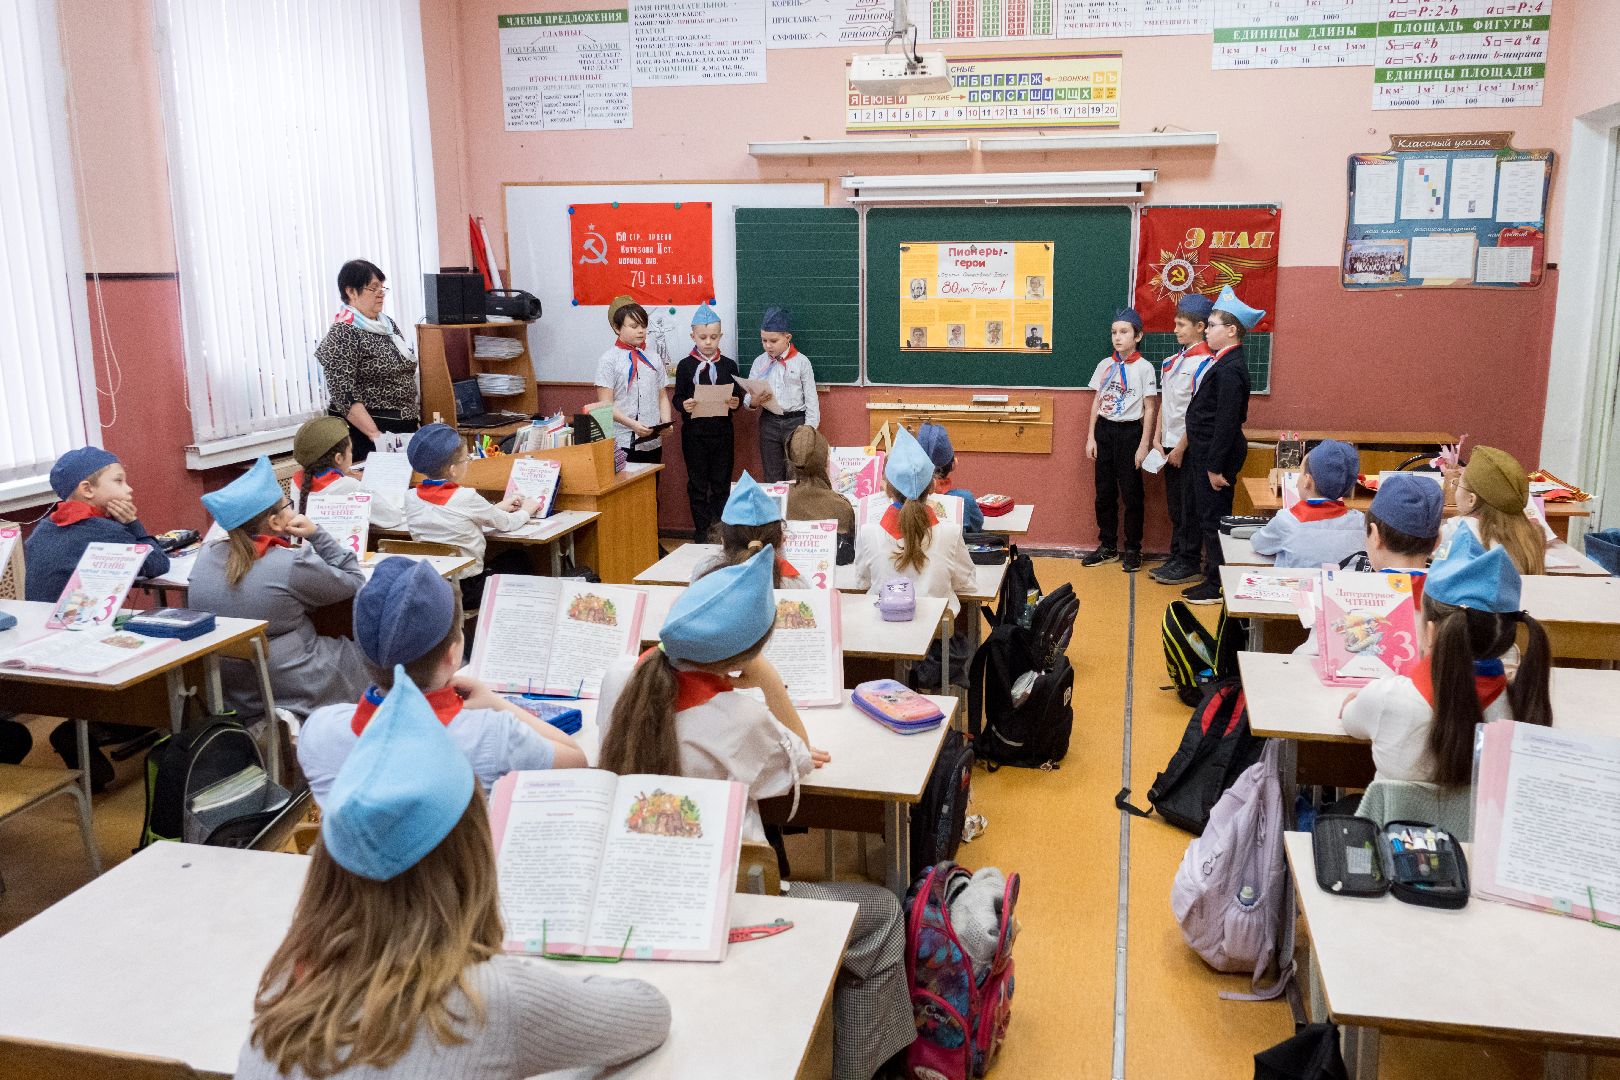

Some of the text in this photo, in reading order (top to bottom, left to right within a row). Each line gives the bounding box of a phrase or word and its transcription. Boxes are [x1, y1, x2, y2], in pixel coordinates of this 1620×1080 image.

[507, 12, 622, 26] ЧЛЕНЫ ПРЕДЛОЖЕНИЯ
[1393, 18, 1533, 34] ПЛОЩАДЬ ФИГУРЫ
[542, 29, 583, 38] ГЛАВНЫЕ
[1233, 26, 1357, 42] ЕДИНИЦЫ ДЛИНЫ
[1385, 66, 1533, 82] ЕДИНИЦЫ ПЛОЩАДИ
[878, 111, 883, 119] 3
[917, 110, 922, 118] 6
[957, 109, 963, 117] 9
[968, 109, 978, 117] 10
[995, 108, 1005, 116] 12
[1008, 108, 1018, 116] 13
[1022, 107, 1032, 115] 14
[1036, 107, 1046, 115] 15
[1049, 107, 1059, 115] 16
[1077, 106, 1087, 114] 18
[1091, 106, 1101, 114] 19
[1397, 138, 1491, 149] Классный уголок
[616, 231, 627, 242] 150
[1184, 227, 1275, 249] 9 МАЯ
[948, 247, 1008, 258] Пионеры-
[955, 258, 986, 270] герои
[630, 270, 646, 288] 79
[941, 281, 959, 294] 80
[863, 478, 872, 496] 3
[346, 534, 360, 553] 3
[785, 540, 820, 548] ТЕНИЕ
[1335, 588, 1395, 599] Литературное
[97, 595, 117, 622] 3
[1345, 598, 1387, 607] ЧТЕНИЕ
[1392, 630, 1416, 662] 3
